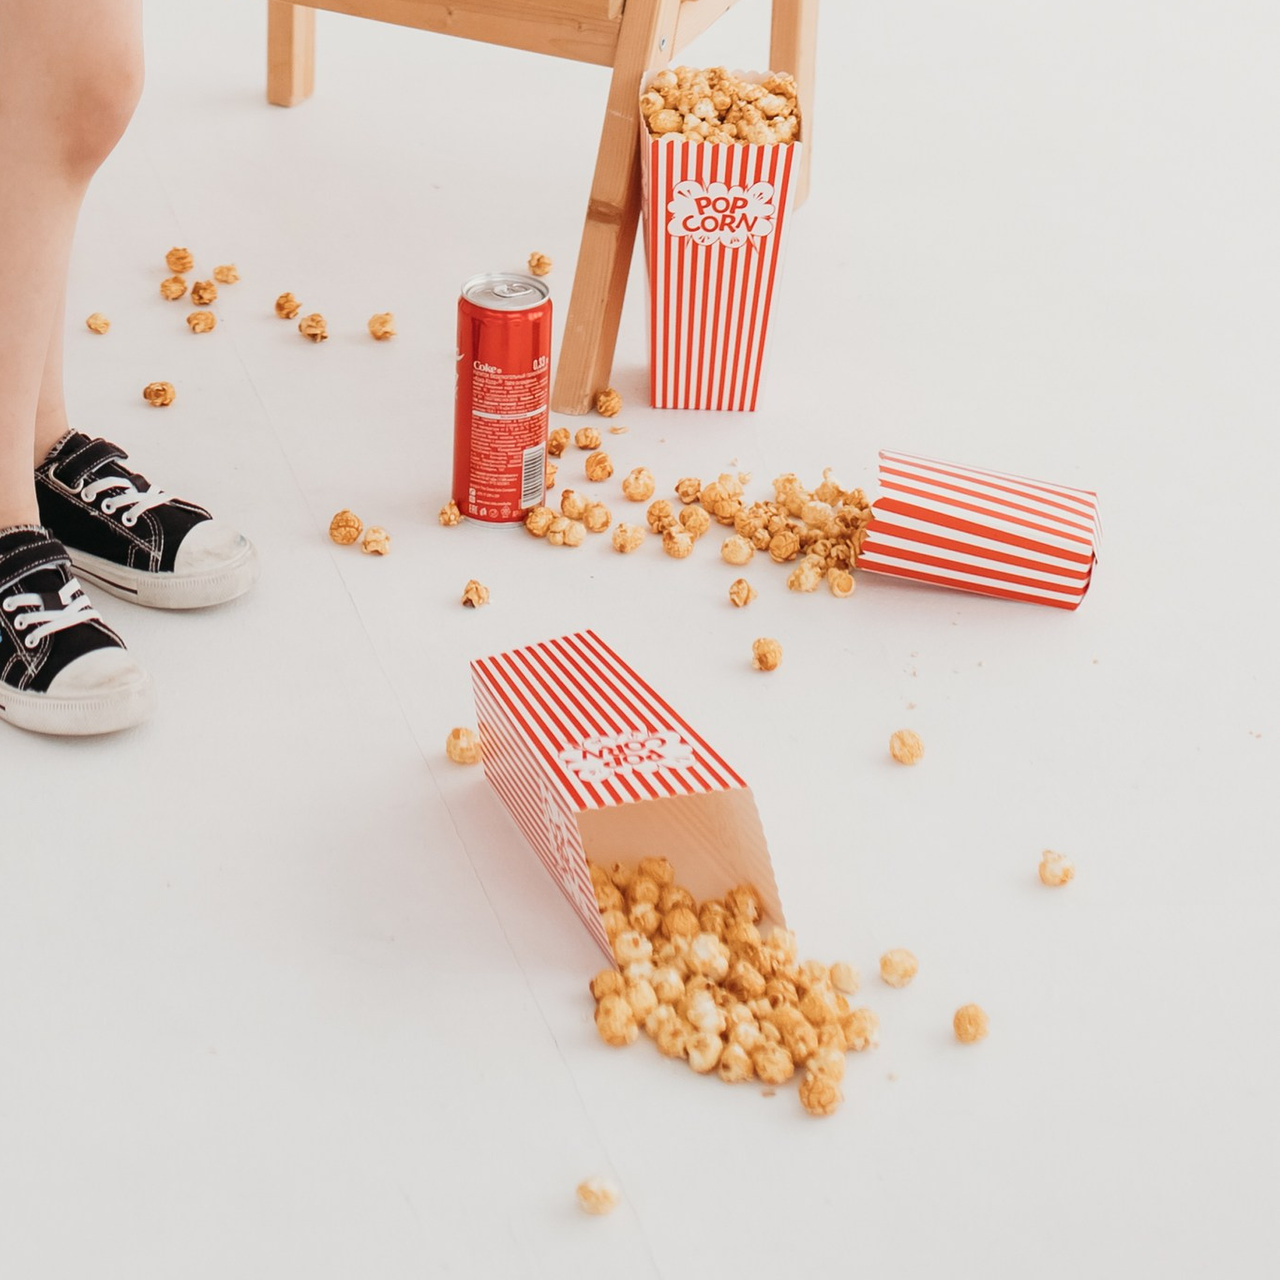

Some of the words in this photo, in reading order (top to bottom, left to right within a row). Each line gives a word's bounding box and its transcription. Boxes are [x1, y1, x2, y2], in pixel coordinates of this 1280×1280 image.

[694, 196, 748, 215] POP
[682, 212, 758, 233] CORN
[473, 360, 497, 373] Coke
[582, 737, 667, 760] CORN
[603, 749, 665, 769] POP
